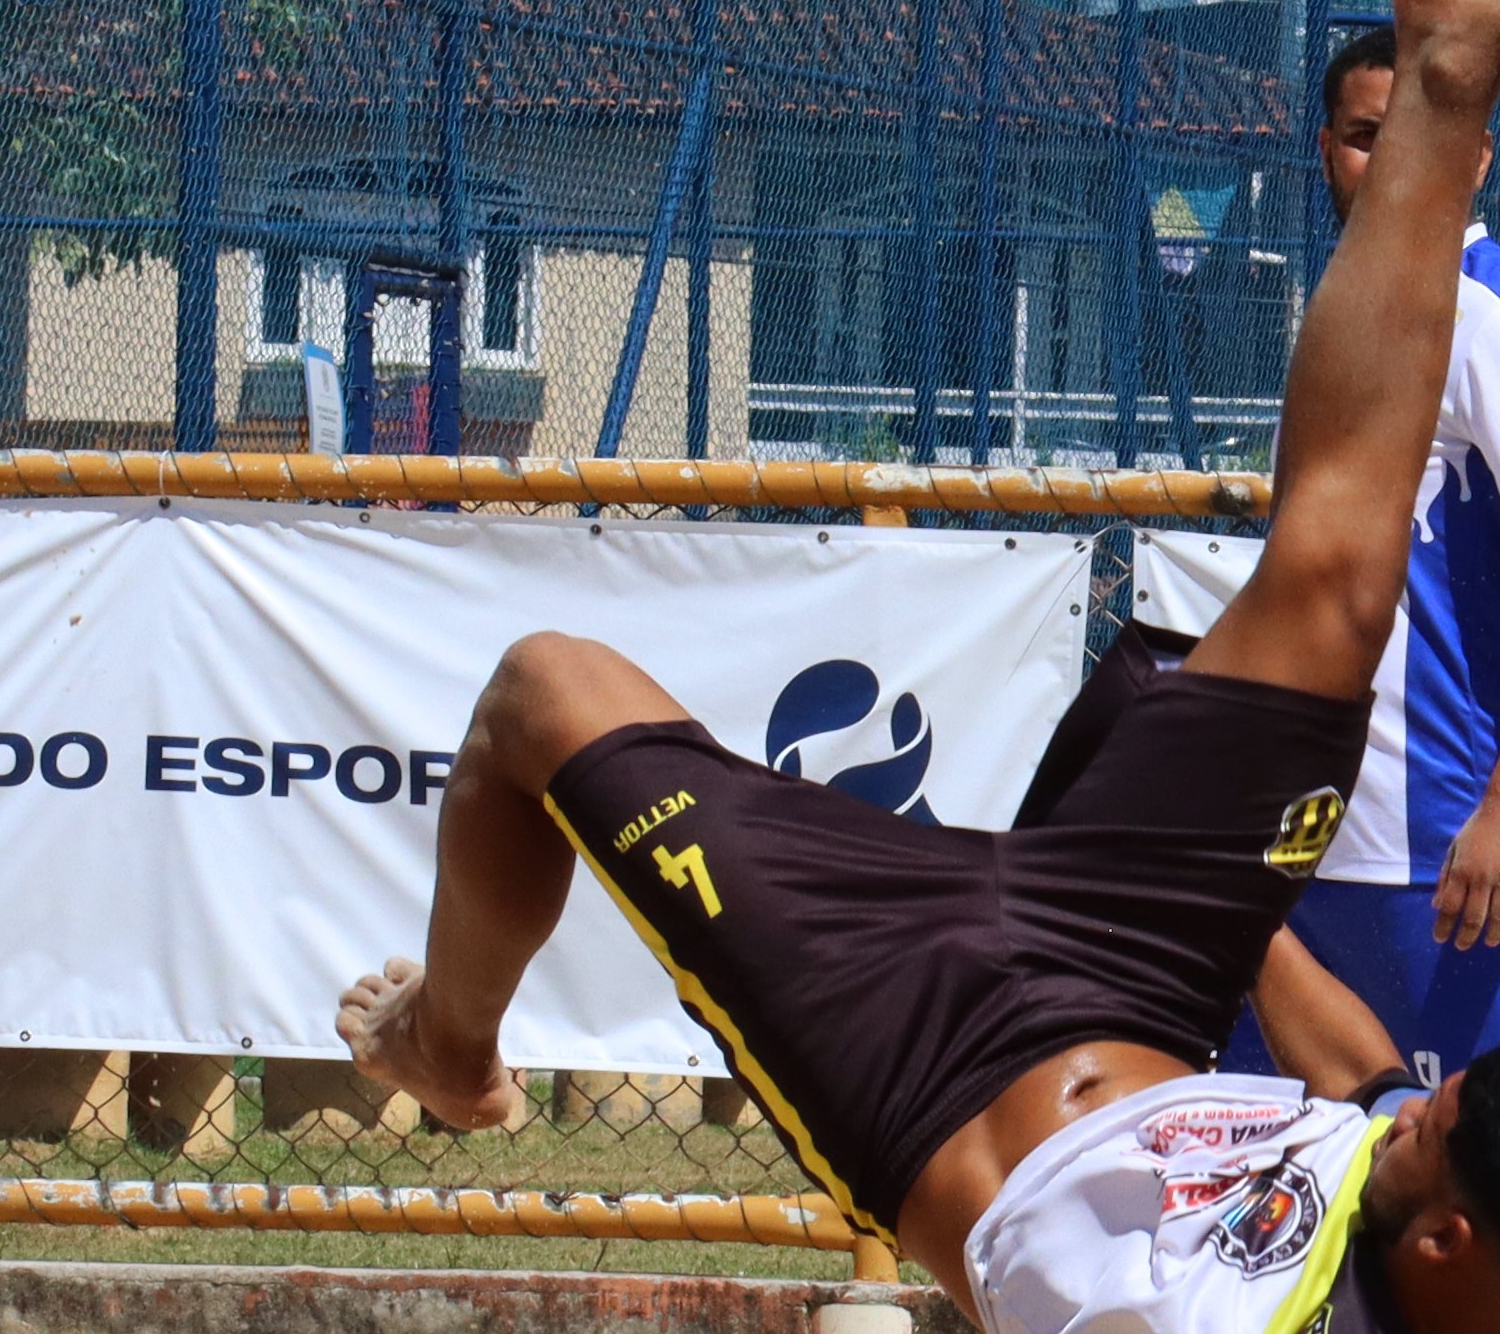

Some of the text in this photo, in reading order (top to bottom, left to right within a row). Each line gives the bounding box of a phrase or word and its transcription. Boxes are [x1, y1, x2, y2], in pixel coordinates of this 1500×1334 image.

[145, 735, 452, 806] ESPOR
[613, 789, 697, 854] VETTOR
[651, 843, 723, 920] 4
